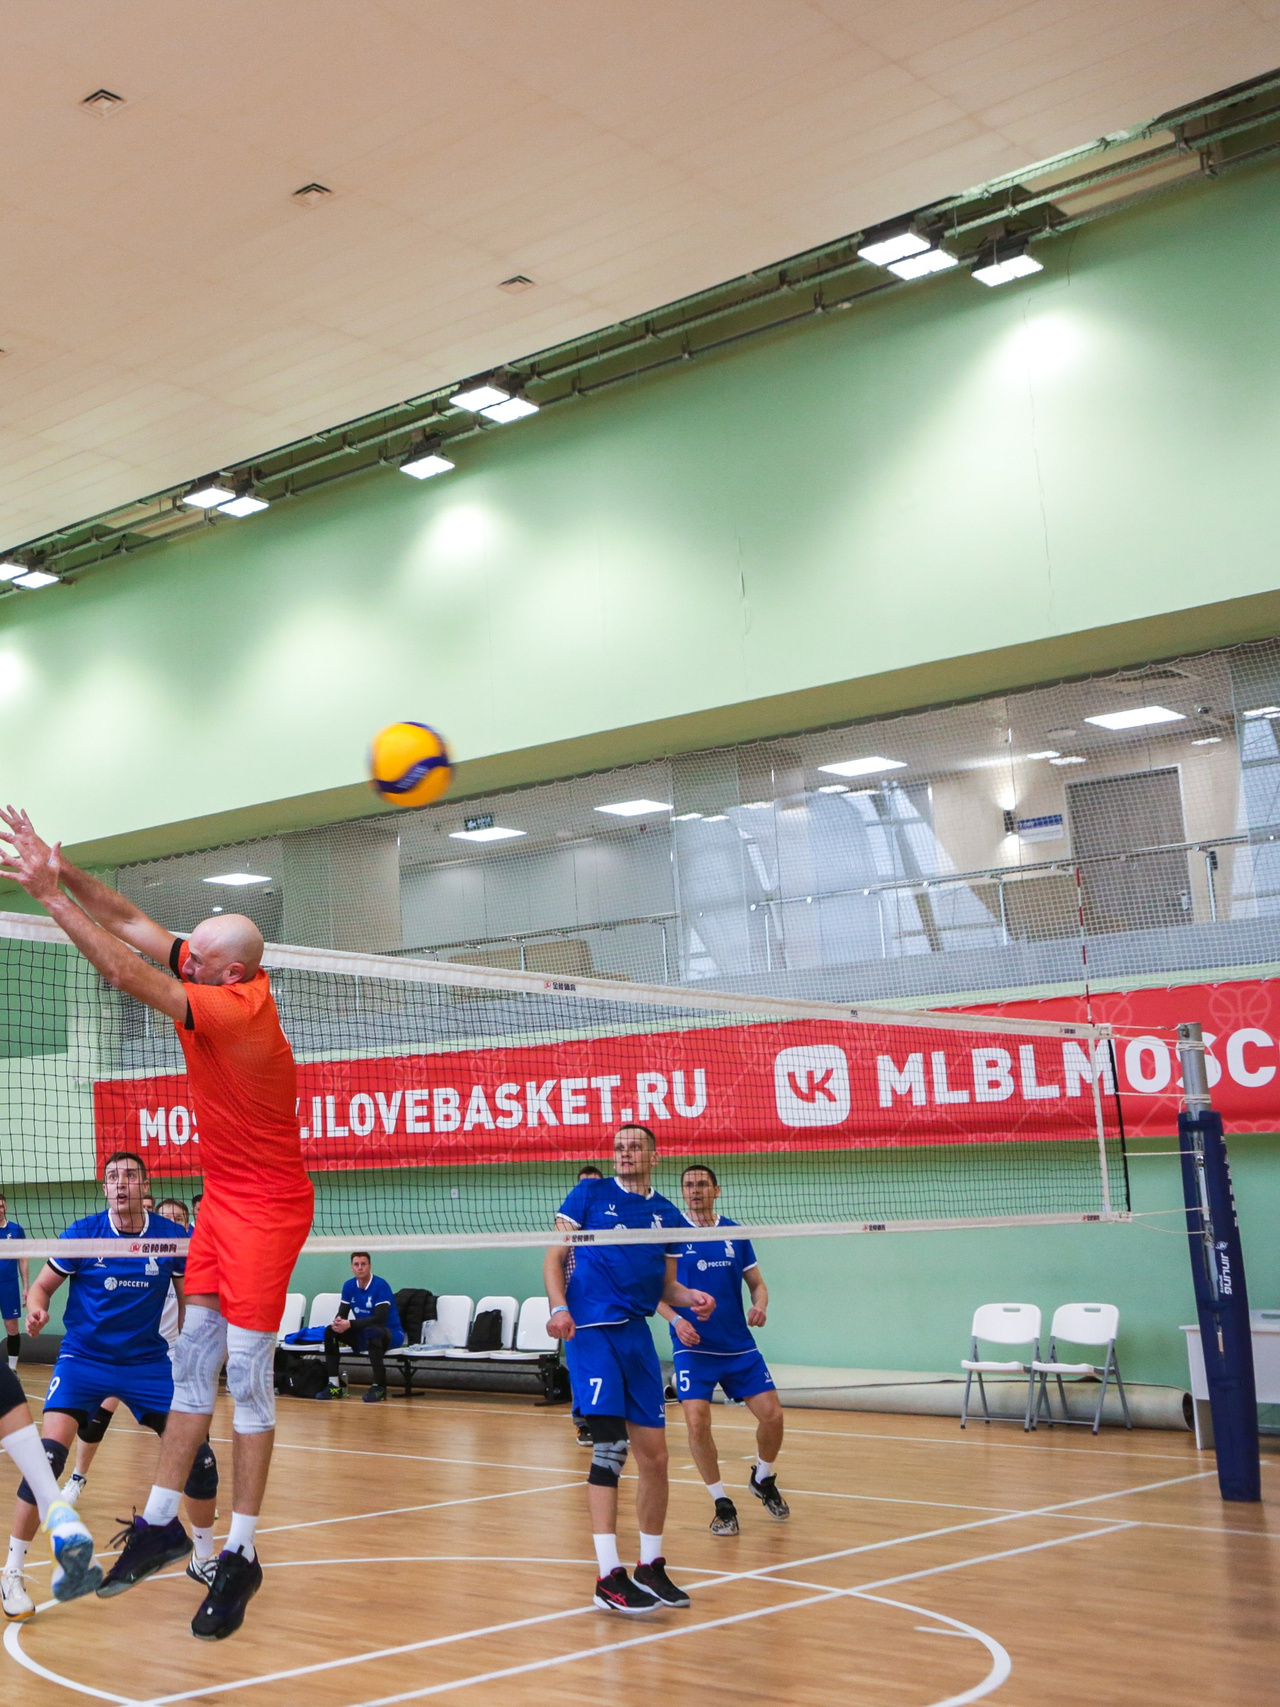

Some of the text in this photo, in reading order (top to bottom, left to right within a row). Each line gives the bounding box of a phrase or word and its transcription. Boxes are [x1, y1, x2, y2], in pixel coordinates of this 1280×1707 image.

[876, 1027, 1280, 1108] MLBLMOSC
[118, 1280, 149, 1288] РОССЕТИ
[47, 1376, 61, 1401] 9
[589, 1377, 603, 1406] 7
[679, 1369, 691, 1392] 5
